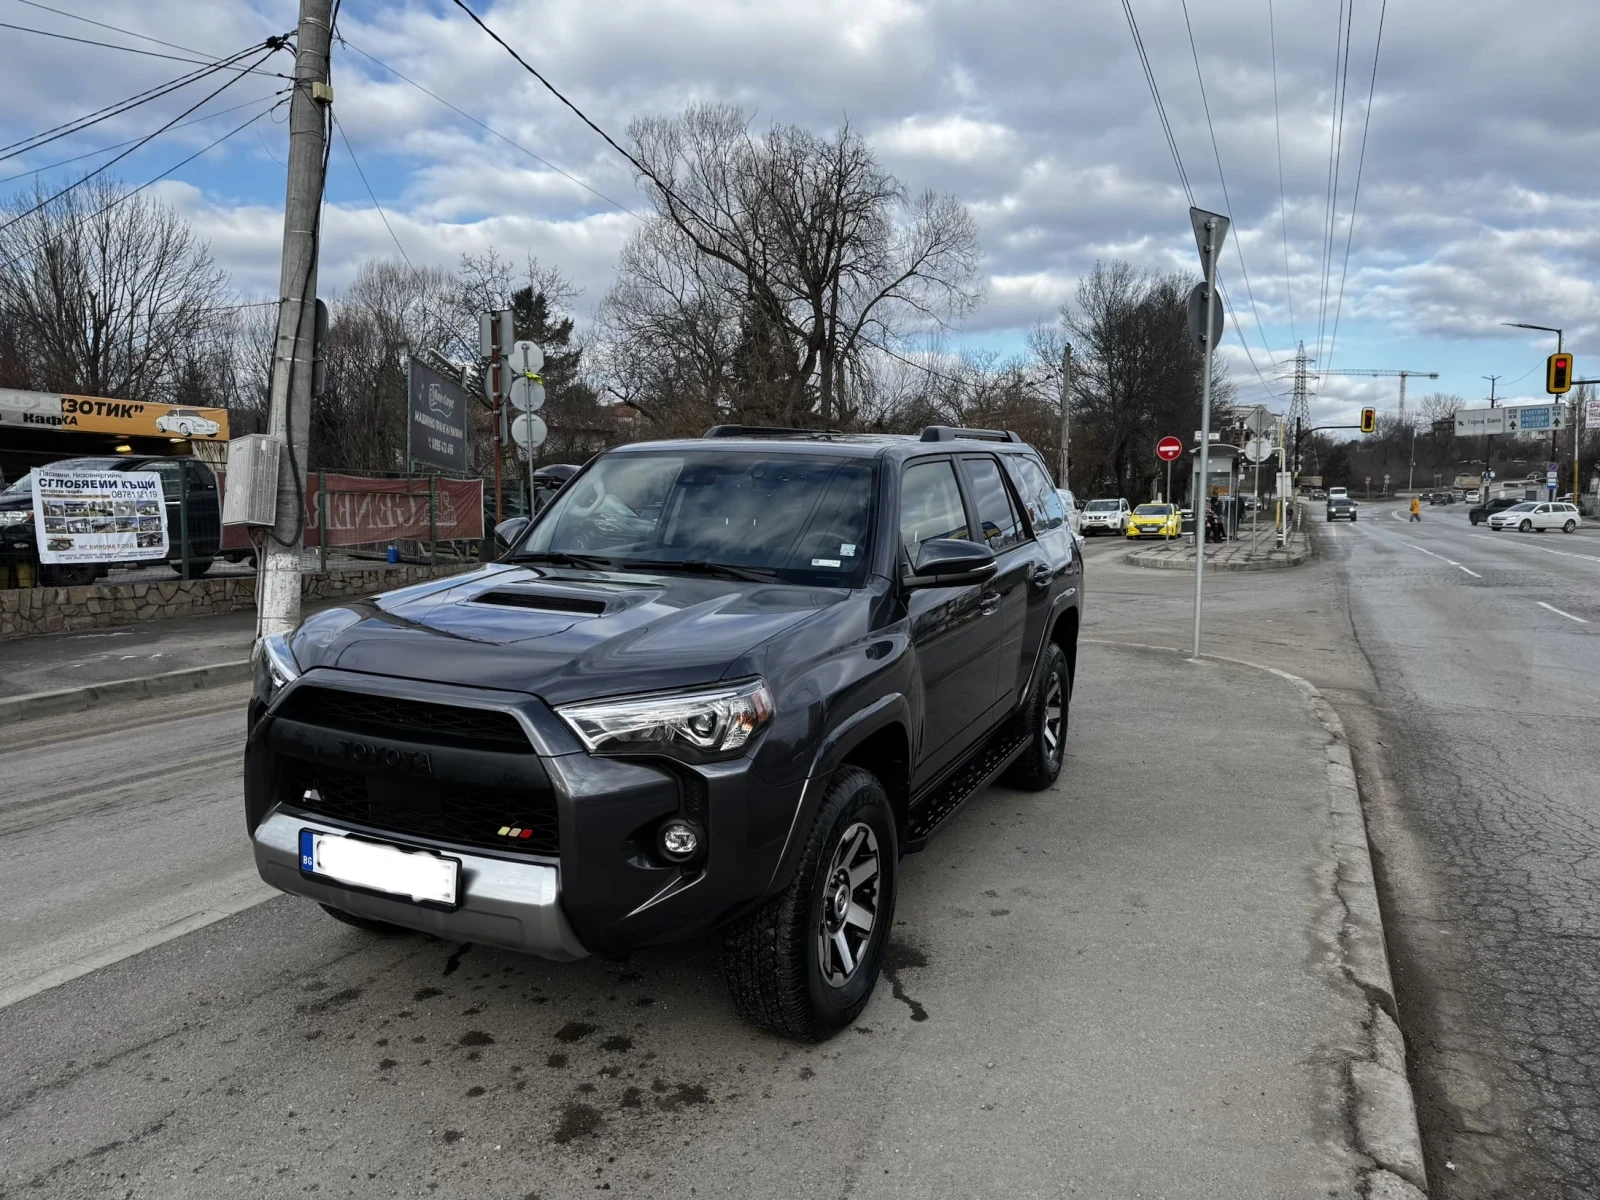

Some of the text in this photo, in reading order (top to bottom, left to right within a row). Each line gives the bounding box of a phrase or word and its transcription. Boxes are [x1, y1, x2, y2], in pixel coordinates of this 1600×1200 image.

[38, 478, 156, 490] СГЛОБЯЕМИ КЪЩИ
[339, 740, 433, 774] TOYOTA
[303, 855, 313, 866] BG
